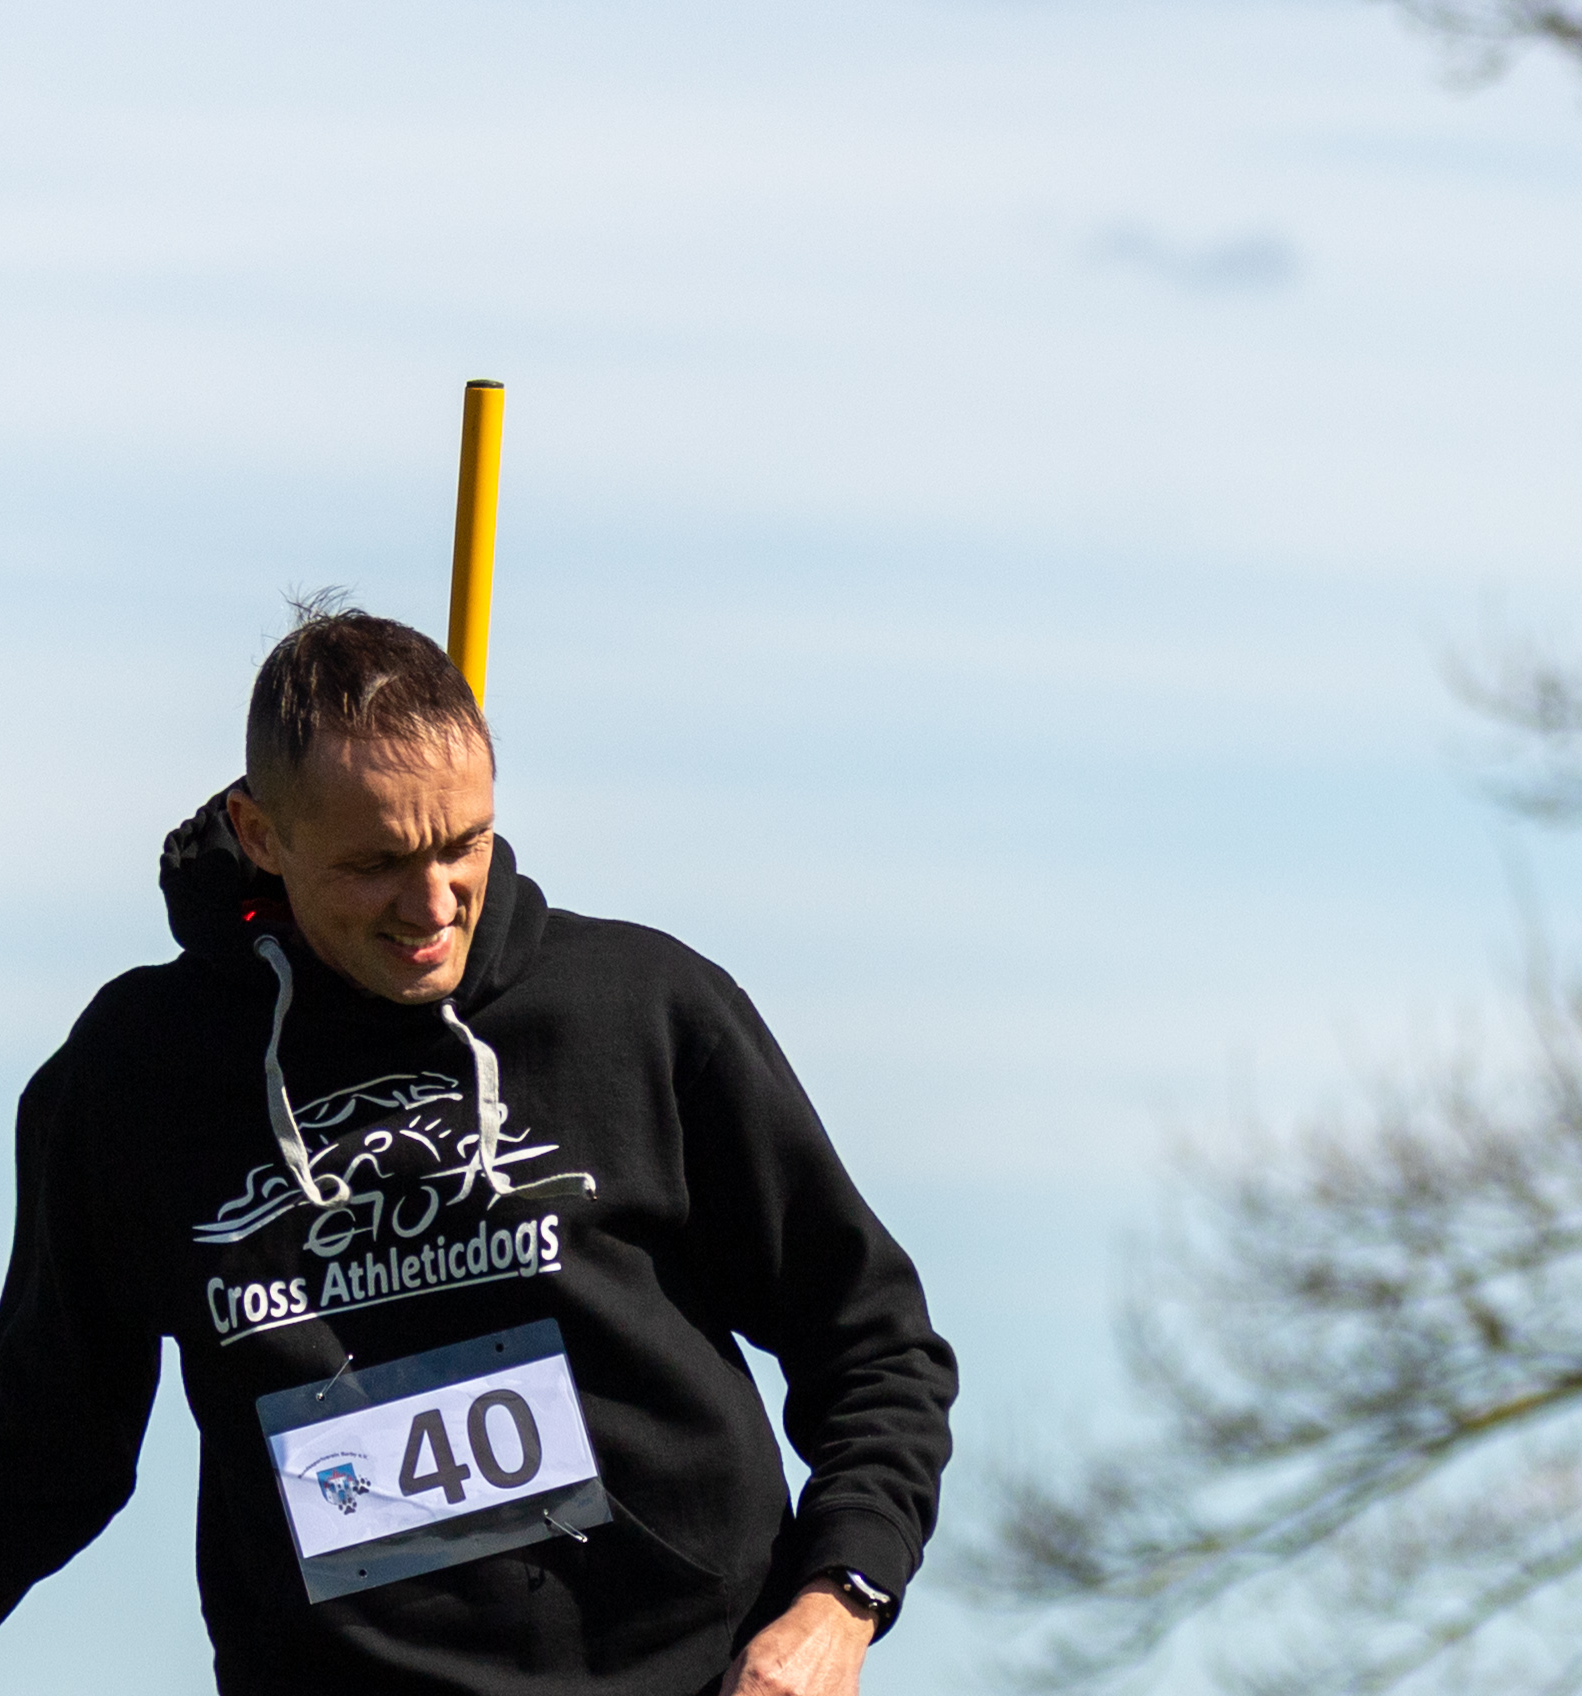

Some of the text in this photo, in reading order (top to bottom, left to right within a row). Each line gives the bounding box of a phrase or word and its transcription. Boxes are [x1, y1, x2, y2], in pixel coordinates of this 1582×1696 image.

[207, 1214, 559, 1333] Cross Athleticdogs
[399, 1388, 542, 1505] 40
